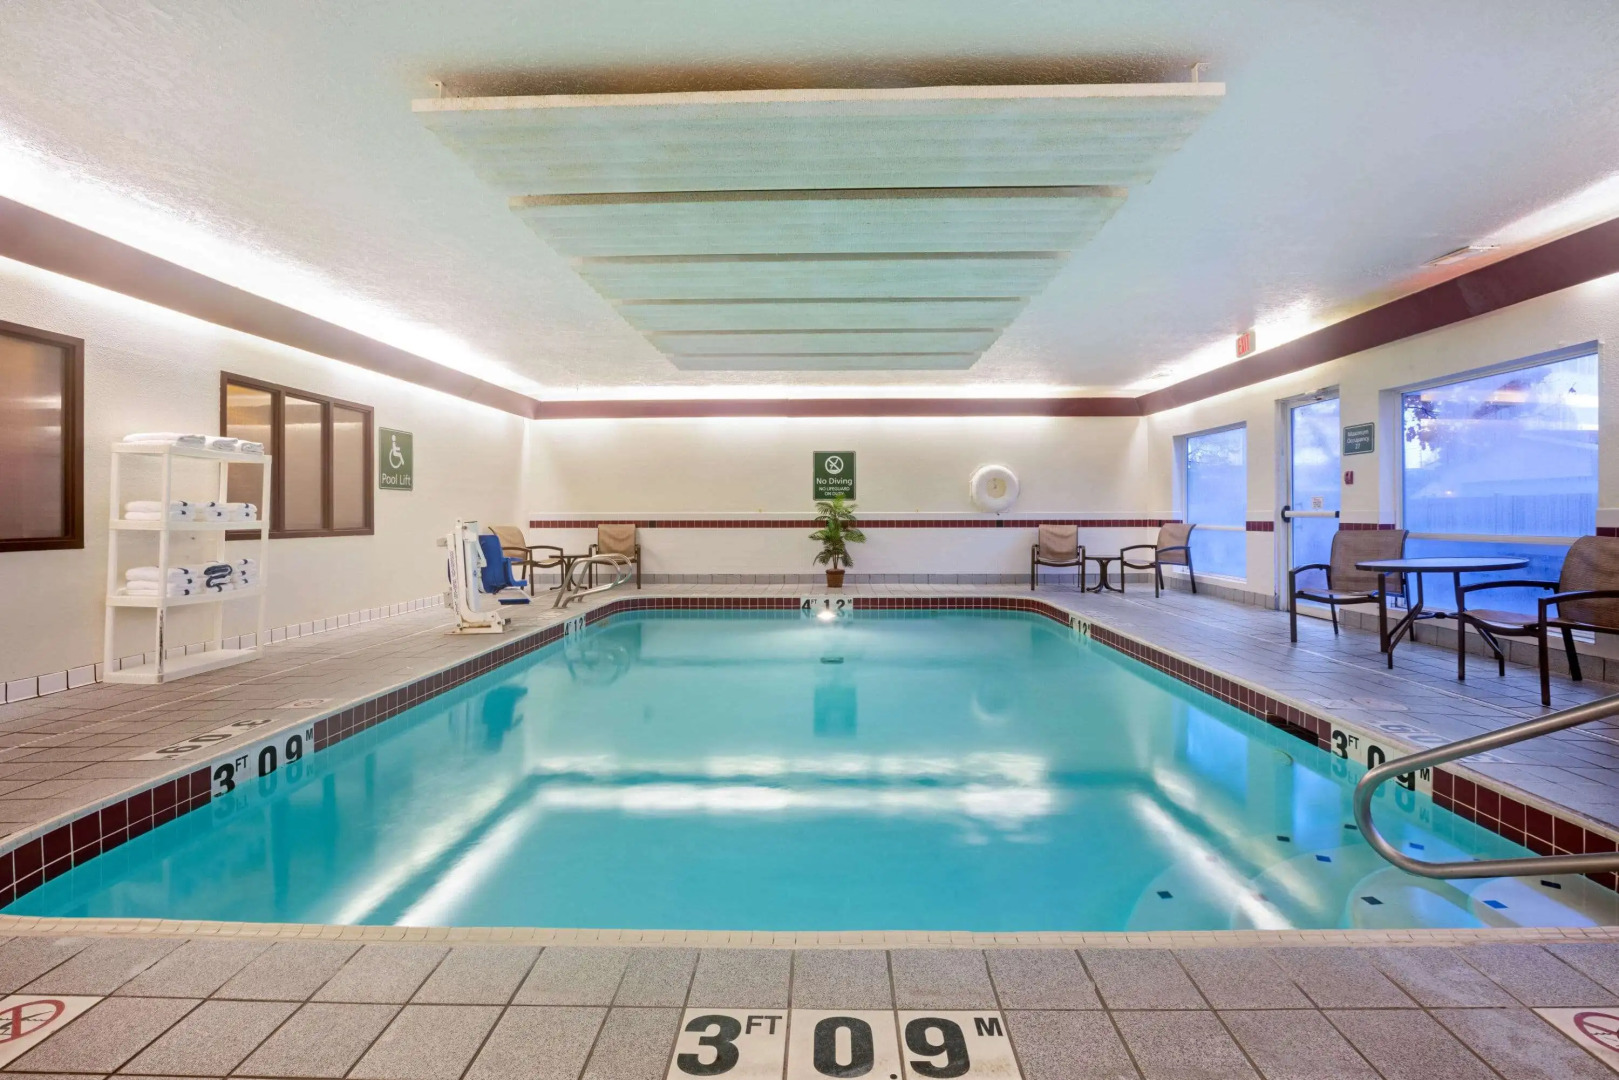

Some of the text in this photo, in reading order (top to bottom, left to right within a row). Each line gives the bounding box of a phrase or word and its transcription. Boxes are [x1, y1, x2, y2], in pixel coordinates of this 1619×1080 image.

[1237, 333, 1250, 356] EXIT
[381, 473, 411, 486] Pool Lift
[829, 477, 853, 486] Diving
